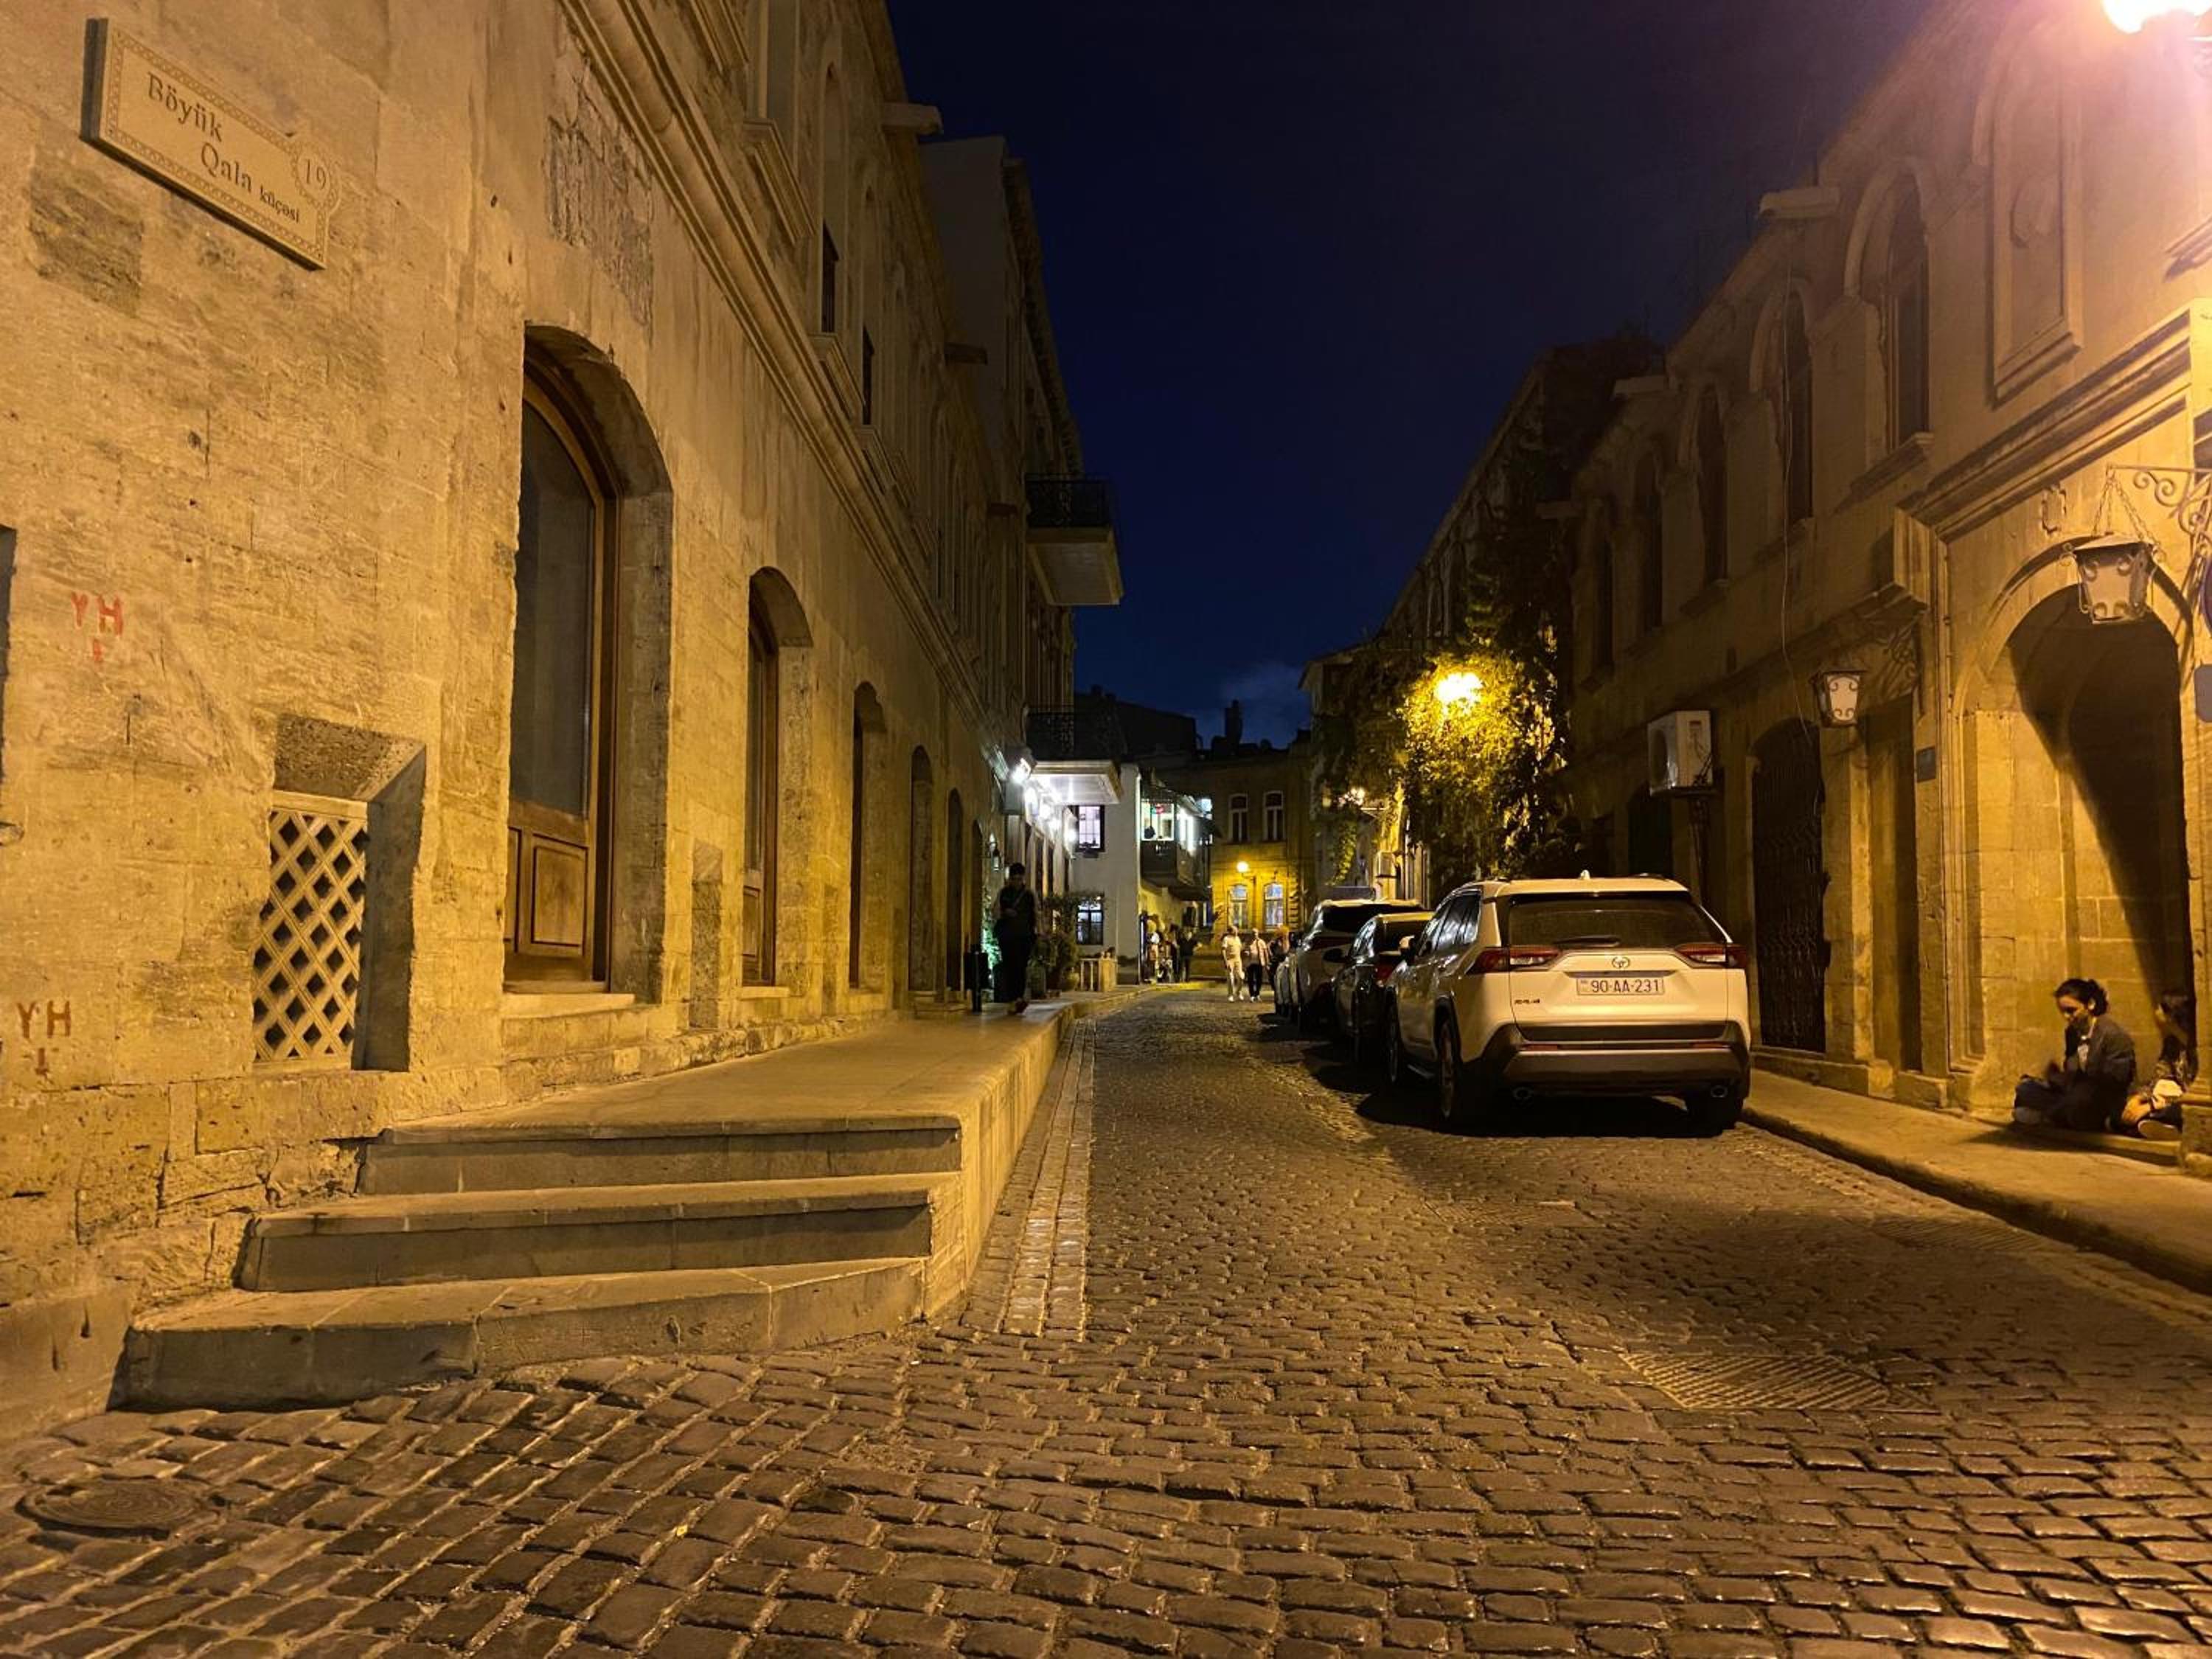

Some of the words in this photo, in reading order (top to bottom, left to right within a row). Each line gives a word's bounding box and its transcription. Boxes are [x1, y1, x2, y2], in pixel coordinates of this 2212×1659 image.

[148, 72, 222, 142] Böyük
[201, 142, 251, 193] Qala
[305, 159, 327, 189] 19
